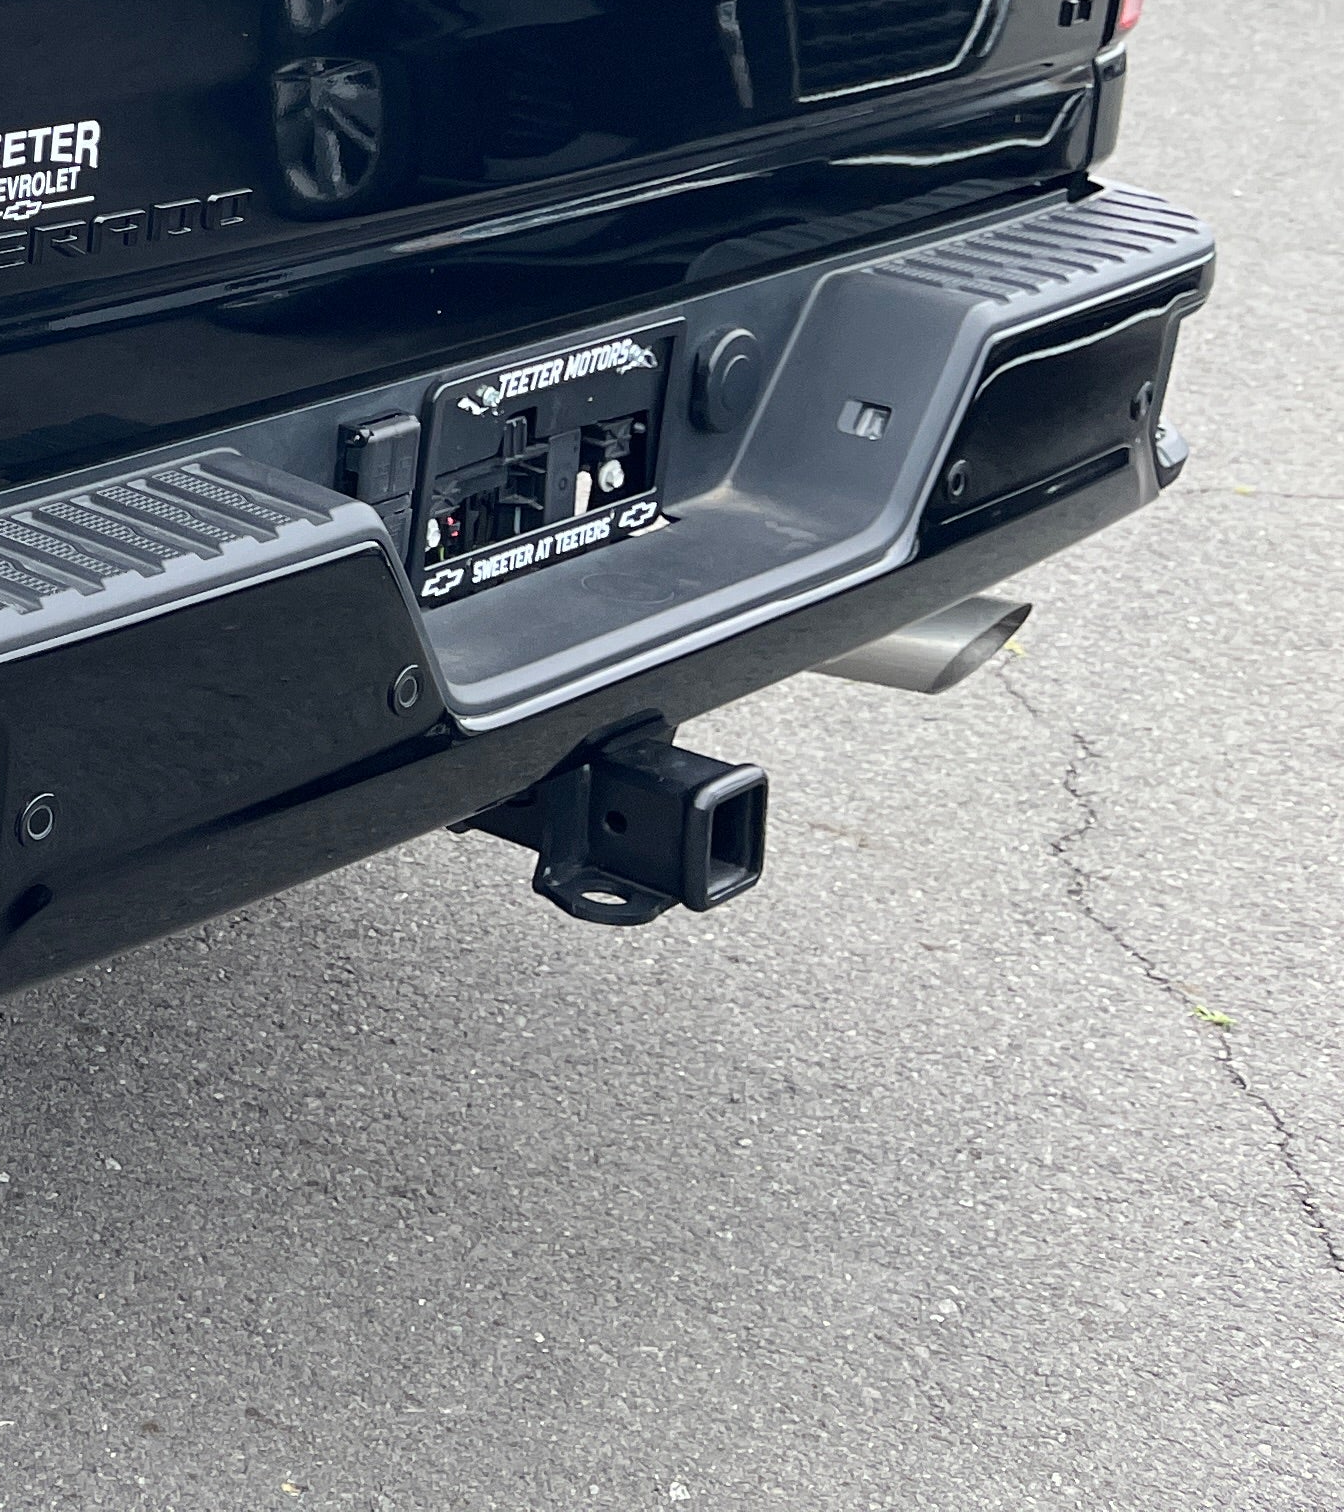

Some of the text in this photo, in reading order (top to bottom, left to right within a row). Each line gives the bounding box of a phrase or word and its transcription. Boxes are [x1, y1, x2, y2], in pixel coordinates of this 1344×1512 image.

[497, 338, 633, 400] TEETER MOTORS
[471, 547, 535, 584] SWEETER
[535, 537, 555, 562] AT
